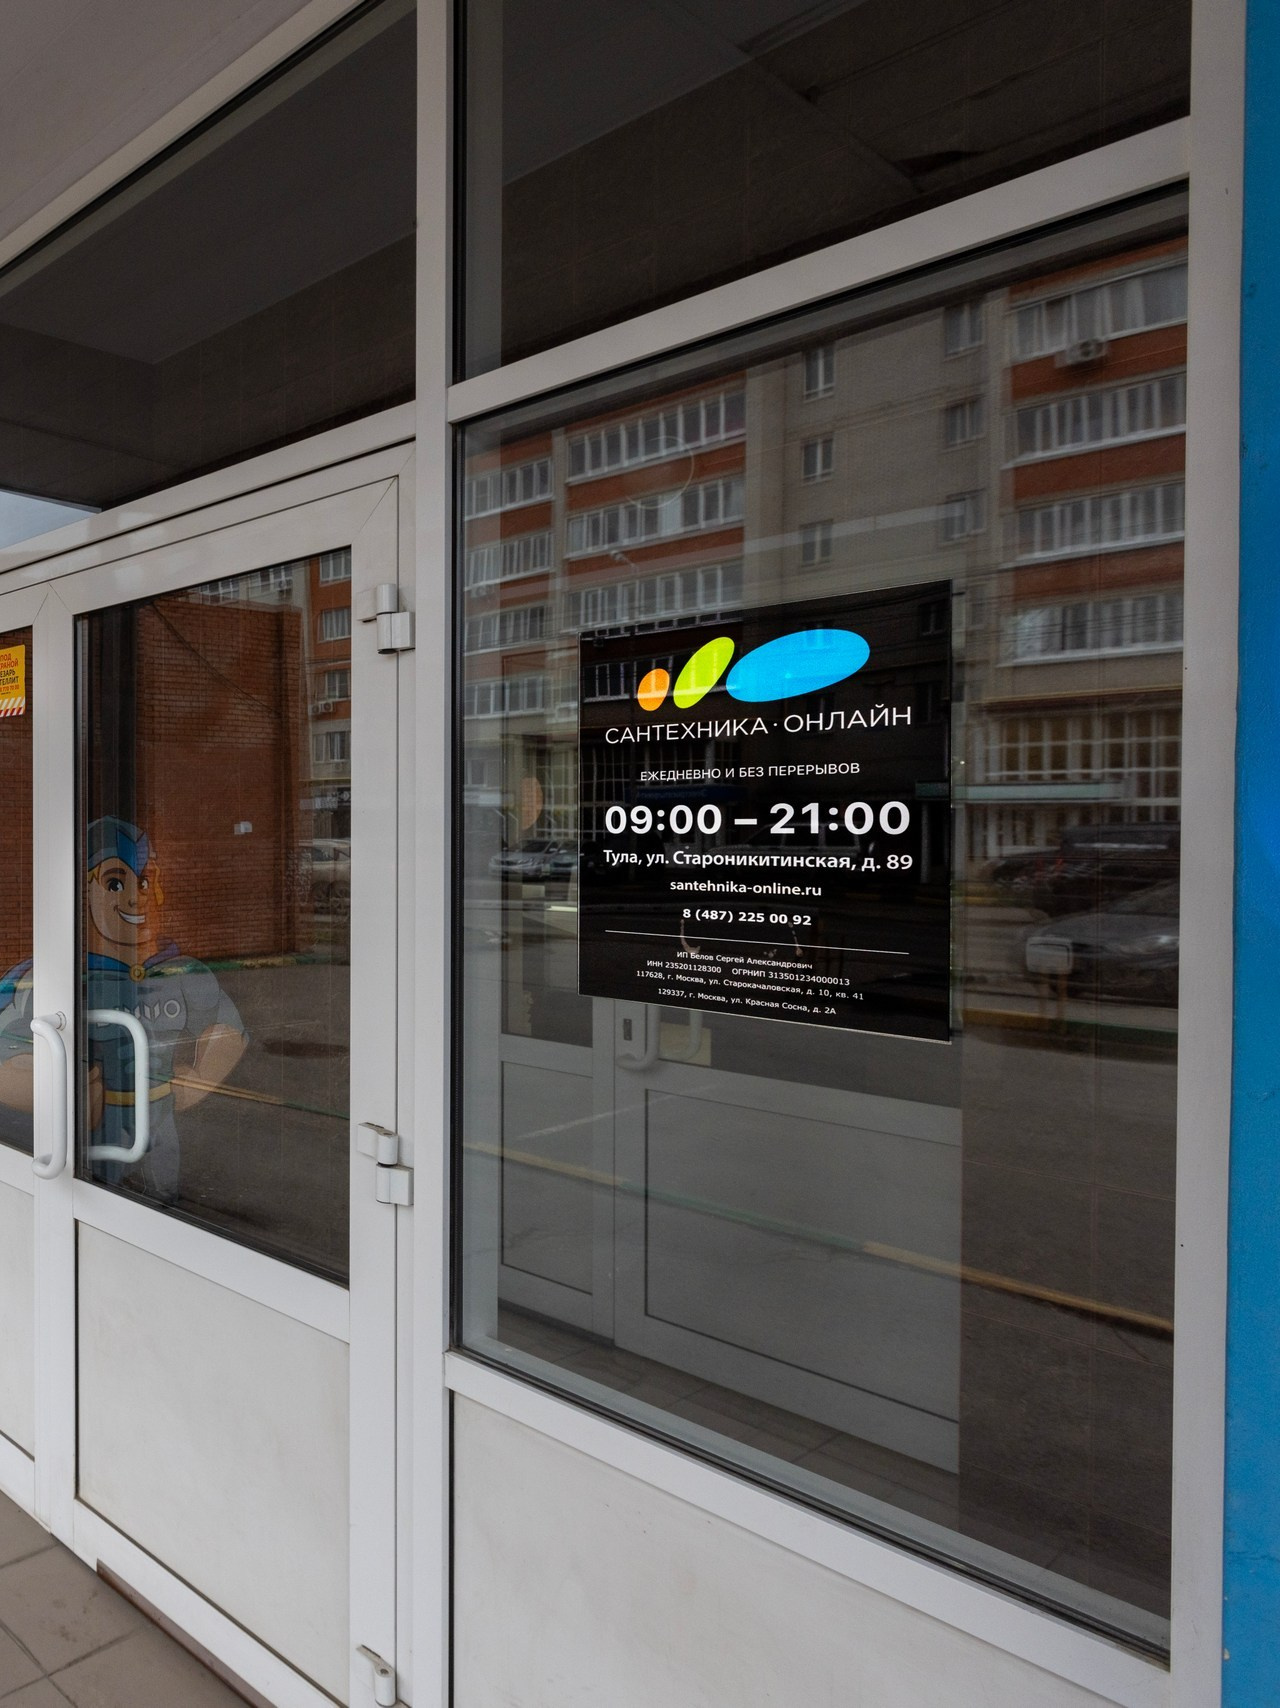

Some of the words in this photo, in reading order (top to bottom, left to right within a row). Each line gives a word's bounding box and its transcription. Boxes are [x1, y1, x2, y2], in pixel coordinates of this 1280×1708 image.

[0, 653, 11, 661] ПОД
[605, 717, 768, 744] САНТЕХНИКА
[783, 704, 912, 733] ОНЛАЙН
[640, 768, 721, 782] ЕЖЕДНЕВНО
[725, 768, 735, 778] И
[739, 767, 764, 778] БЕЗ
[768, 762, 860, 777] ПЕРЕРЫВОВ
[605, 804, 722, 835] 09:00
[769, 801, 911, 835] 21:00
[603, 849, 642, 866] Тула,
[646, 853, 669, 867] ул.
[673, 850, 857, 871] Староникитинская,
[861, 857, 881, 872] д.
[886, 854, 913, 870] 89
[670, 880, 822, 896] santehnika-online.ru
[683, 908, 691, 918] 8
[695, 909, 733, 923] (487)
[738, 912, 765, 923] 225
[769, 913, 788, 924] 00
[792, 915, 812, 926] 92
[690, 952, 714, 961] Белов
[716, 955, 744, 963] Сергей
[746, 957, 813, 970] Александрович
[636, 970, 665, 980] 117628,
[676, 974, 707, 984] Москва,
[723, 979, 804, 995] Старокачаловская,
[819, 989, 833, 998] 10,
[852, 992, 864, 1000] 41
[665, 961, 722, 973] 235201128300
[732, 968, 766, 978] ОГРНИП
[768, 971, 850, 986] 313501234000013
[658, 988, 687, 998] 129337,
[697, 992, 728, 1003] Москва,
[745, 998, 779, 1008] Красная
[782, 1002, 811, 1013] Сосна,
[824, 1006, 836, 1015] 2А
